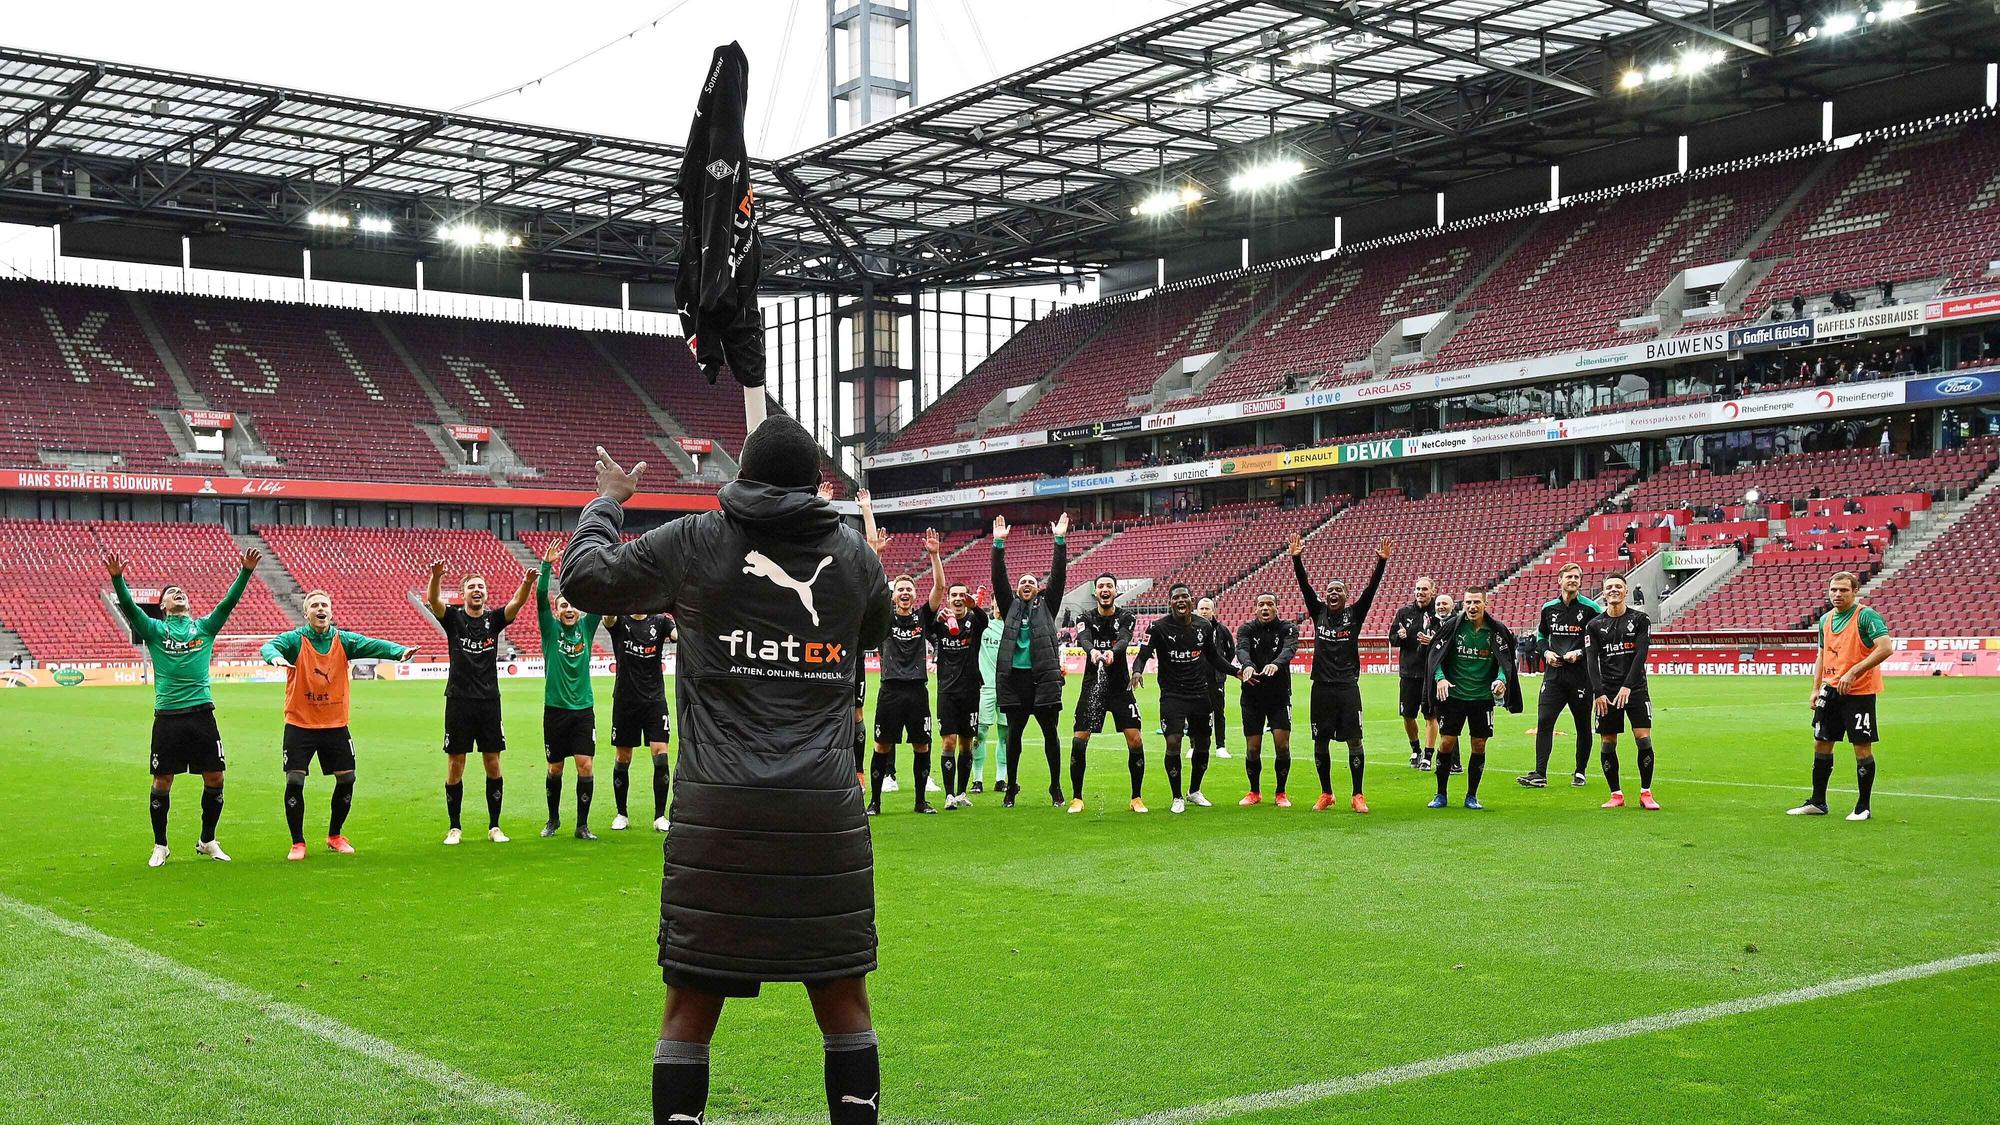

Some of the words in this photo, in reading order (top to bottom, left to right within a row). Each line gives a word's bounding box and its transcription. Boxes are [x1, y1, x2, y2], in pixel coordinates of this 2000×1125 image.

[705, 57, 724, 94] Sonepar
[1817, 318, 1855, 333] GAFFELS
[1857, 309, 1920, 328] FASSBRAUSE
[1743, 331, 1773, 345] Gaffel
[1775, 323, 1810, 341] Kölsch
[1646, 335, 1723, 359] BAUWENS
[40, 306, 525, 409] Köln
[1358, 381, 1412, 397] CARGLASS
[1944, 377, 1975, 393] Ford
[1304, 391, 1341, 406] stewe
[1837, 390, 1894, 404] RheinEnergie
[1243, 399, 1282, 414] REMONDIS
[1741, 401, 1794, 414] RheinEnergie
[1630, 414, 1686, 426] Kreissparkasse
[1688, 411, 1706, 419] Köln
[1472, 431, 1508, 444] Sparkasse
[1509, 428, 1546, 440] KölnBonn
[1421, 438, 1467, 450] NetCologne
[1293, 452, 1333, 464] RENAULT
[1347, 443, 1394, 462] DEVK
[19, 473, 51, 488] HANS
[55, 472, 109, 489] SCHÄFER
[113, 474, 173, 492] SÜDKURVE
[1070, 476, 1115, 489] SIEGENIA
[1173, 469, 1209, 481] sunzinet
[730, 665, 765, 676] AKTIEN.
[767, 669, 802, 679] ONLINE.
[804, 671, 845, 681] HANDELN.
[1289, 664, 1306, 673] EWE
[1658, 663, 1693, 675] REWE
[1698, 663, 1735, 675] REWE
[1739, 663, 1777, 675] REWE
[1881, 662, 1910, 671] EWE
[114, 671, 135, 682] Hol
[1854, 712, 1870, 730] 24
